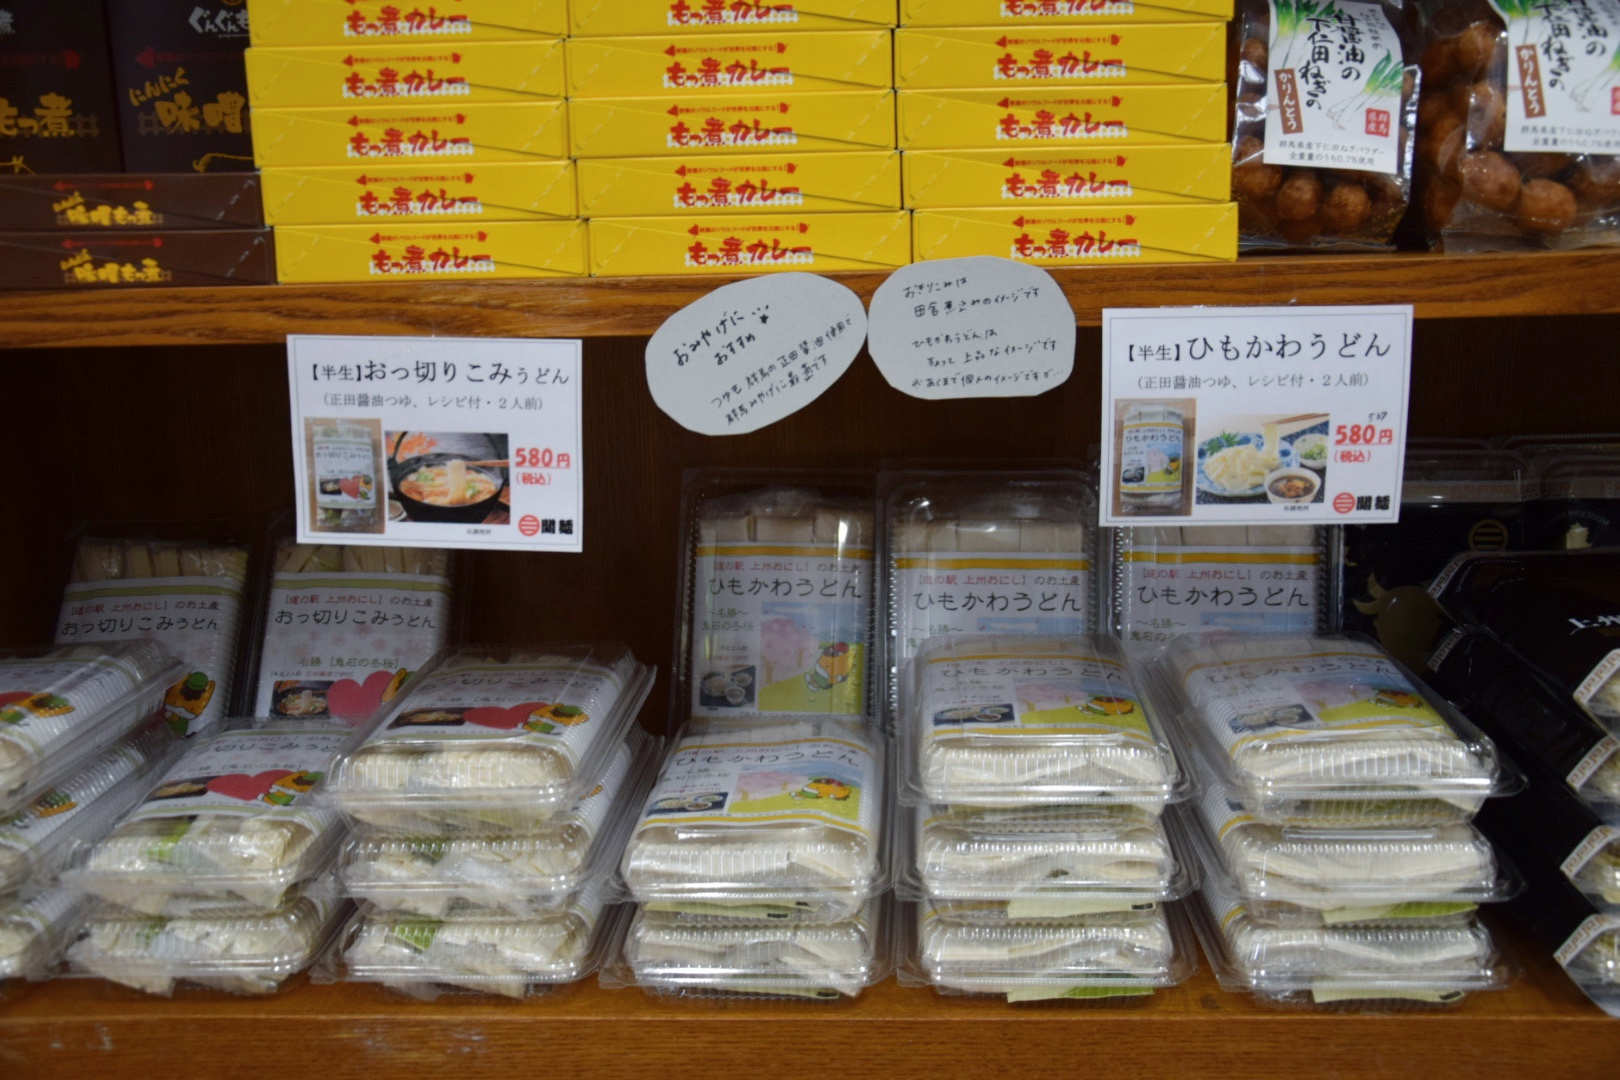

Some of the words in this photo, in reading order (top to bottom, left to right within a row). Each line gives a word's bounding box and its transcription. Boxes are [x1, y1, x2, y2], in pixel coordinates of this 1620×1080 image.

[129, 66, 190, 107] にんにく
[1519, 49, 1540, 114] かりんとう
[1278, 71, 1297, 131] かりんとう
[673, 310, 745, 367] おみやげに
[714, 332, 756, 366] おすすめ
[1127, 333, 1392, 362] 【半生】ひもかわうどん
[309, 359, 570, 385] 【半生】おっ切りこみうどん
[1334, 423, 1393, 445] 580円
[515, 447, 571, 469] 580円
[1334, 449, 1371, 463] （税込）
[516, 472, 552, 486] （税込）
[708, 576, 862, 598] ひもかわうどん
[1137, 585, 1310, 607] ひもかわうどん
[913, 591, 1082, 612] ひもかわうどん
[943, 666, 1127, 681] ひもかわうどん
[676, 749, 860, 768] ひもかわうどん
